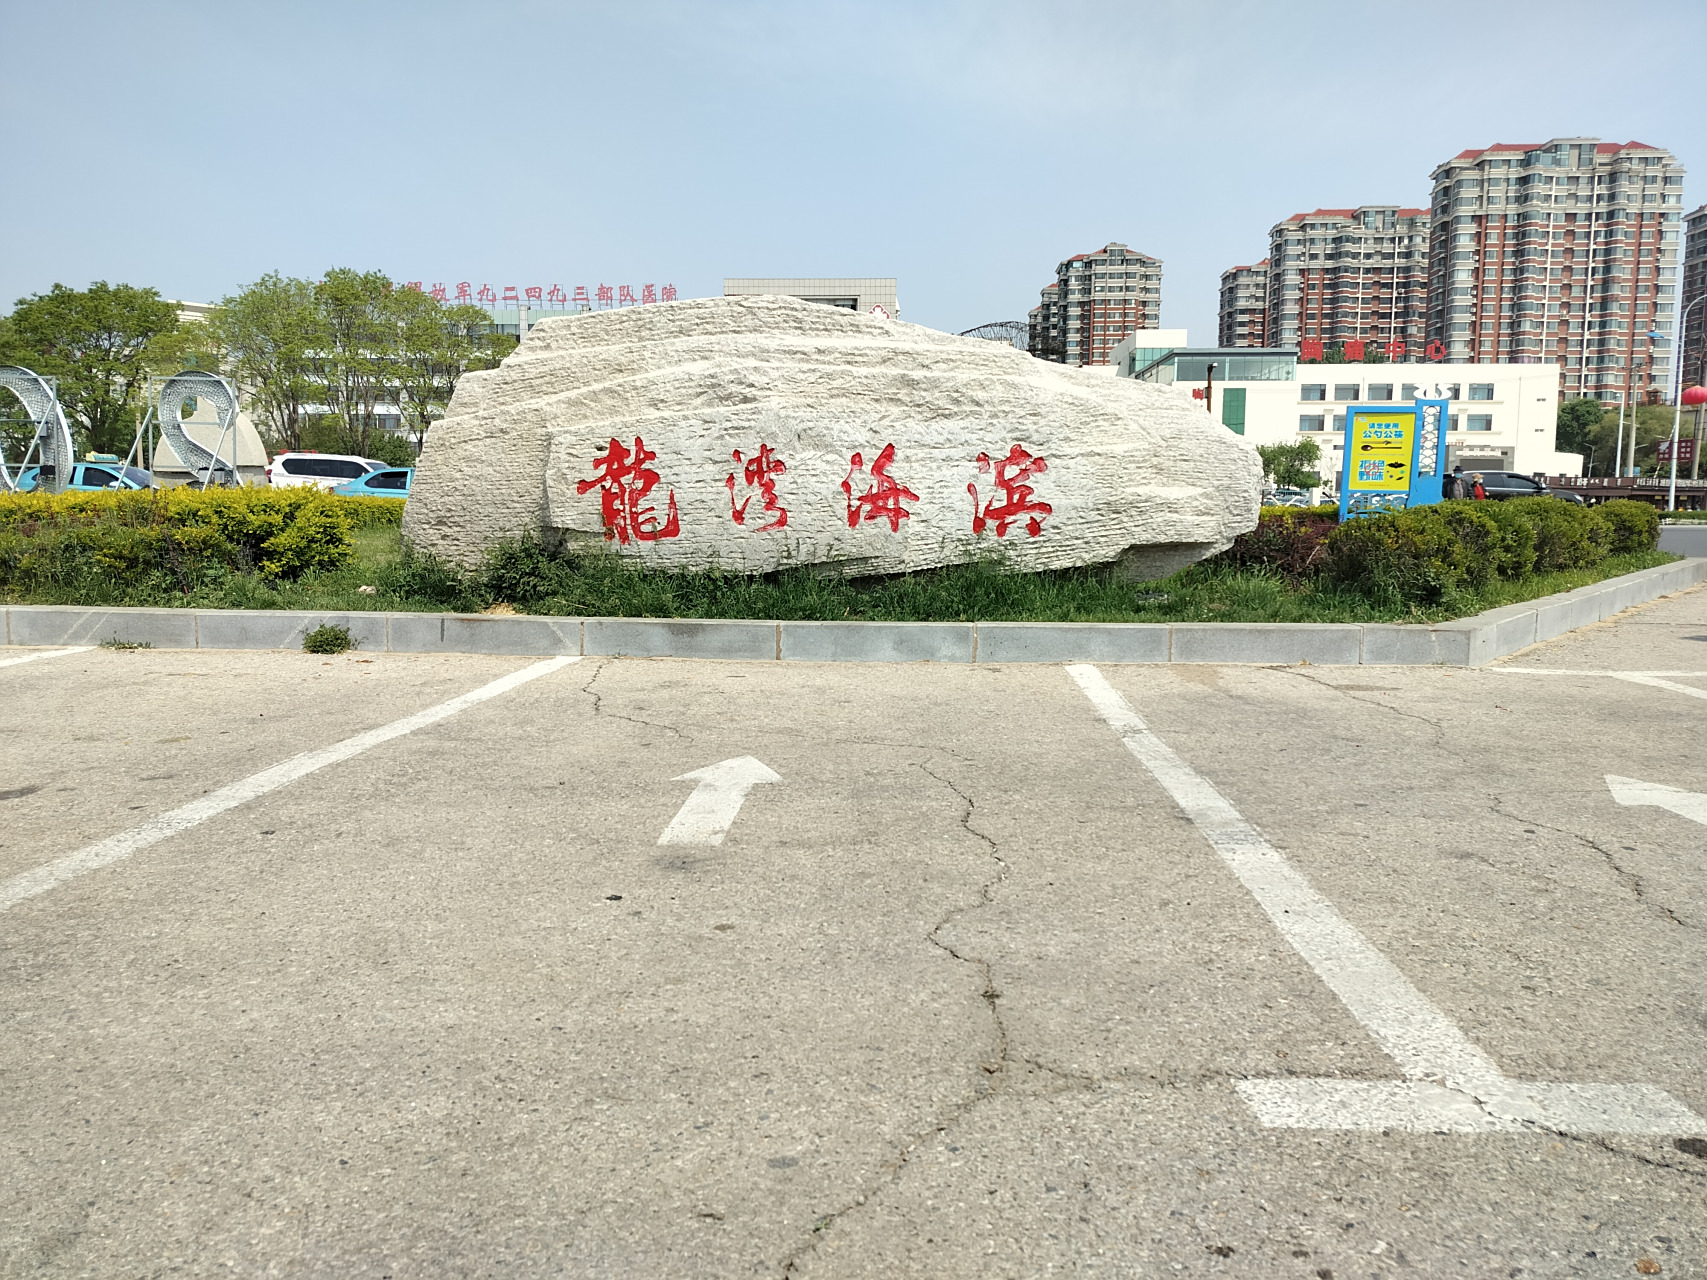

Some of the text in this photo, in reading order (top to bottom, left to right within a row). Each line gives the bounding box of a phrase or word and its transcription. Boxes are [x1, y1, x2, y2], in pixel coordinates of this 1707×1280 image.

[383, 281, 677, 306] 解放军九二四九三部队医院
[1301, 339, 1447, 361] 胸痛中心
[1363, 430, 1404, 438] 公勺公筷
